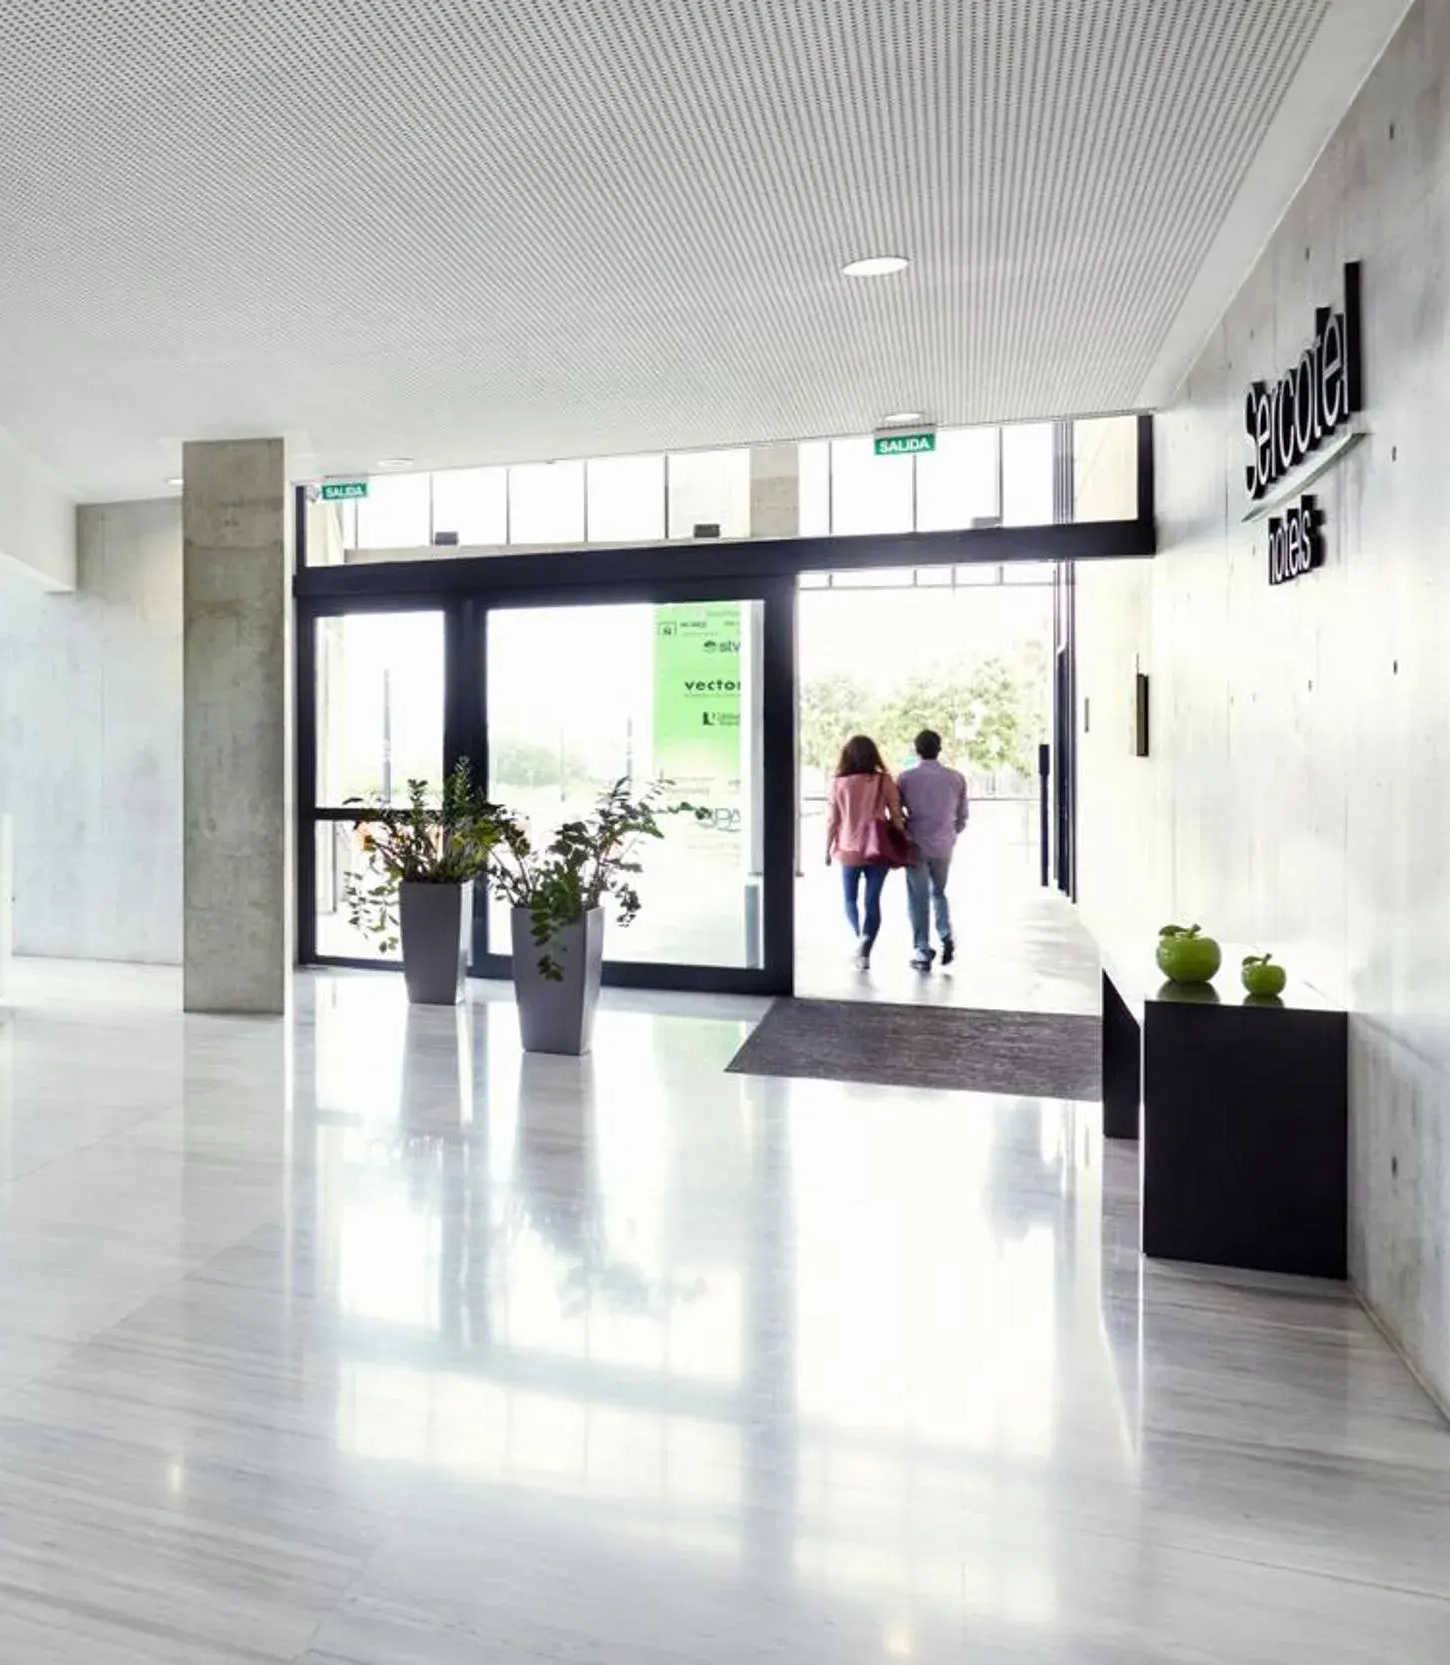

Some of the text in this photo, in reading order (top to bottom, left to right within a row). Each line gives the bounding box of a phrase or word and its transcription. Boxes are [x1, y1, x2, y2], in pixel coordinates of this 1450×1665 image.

[1245, 261, 1361, 499] Sercotel
[879, 437, 931, 453] SALIDA
[326, 486, 364, 499] SALIDA
[1268, 495, 1325, 586] hotels
